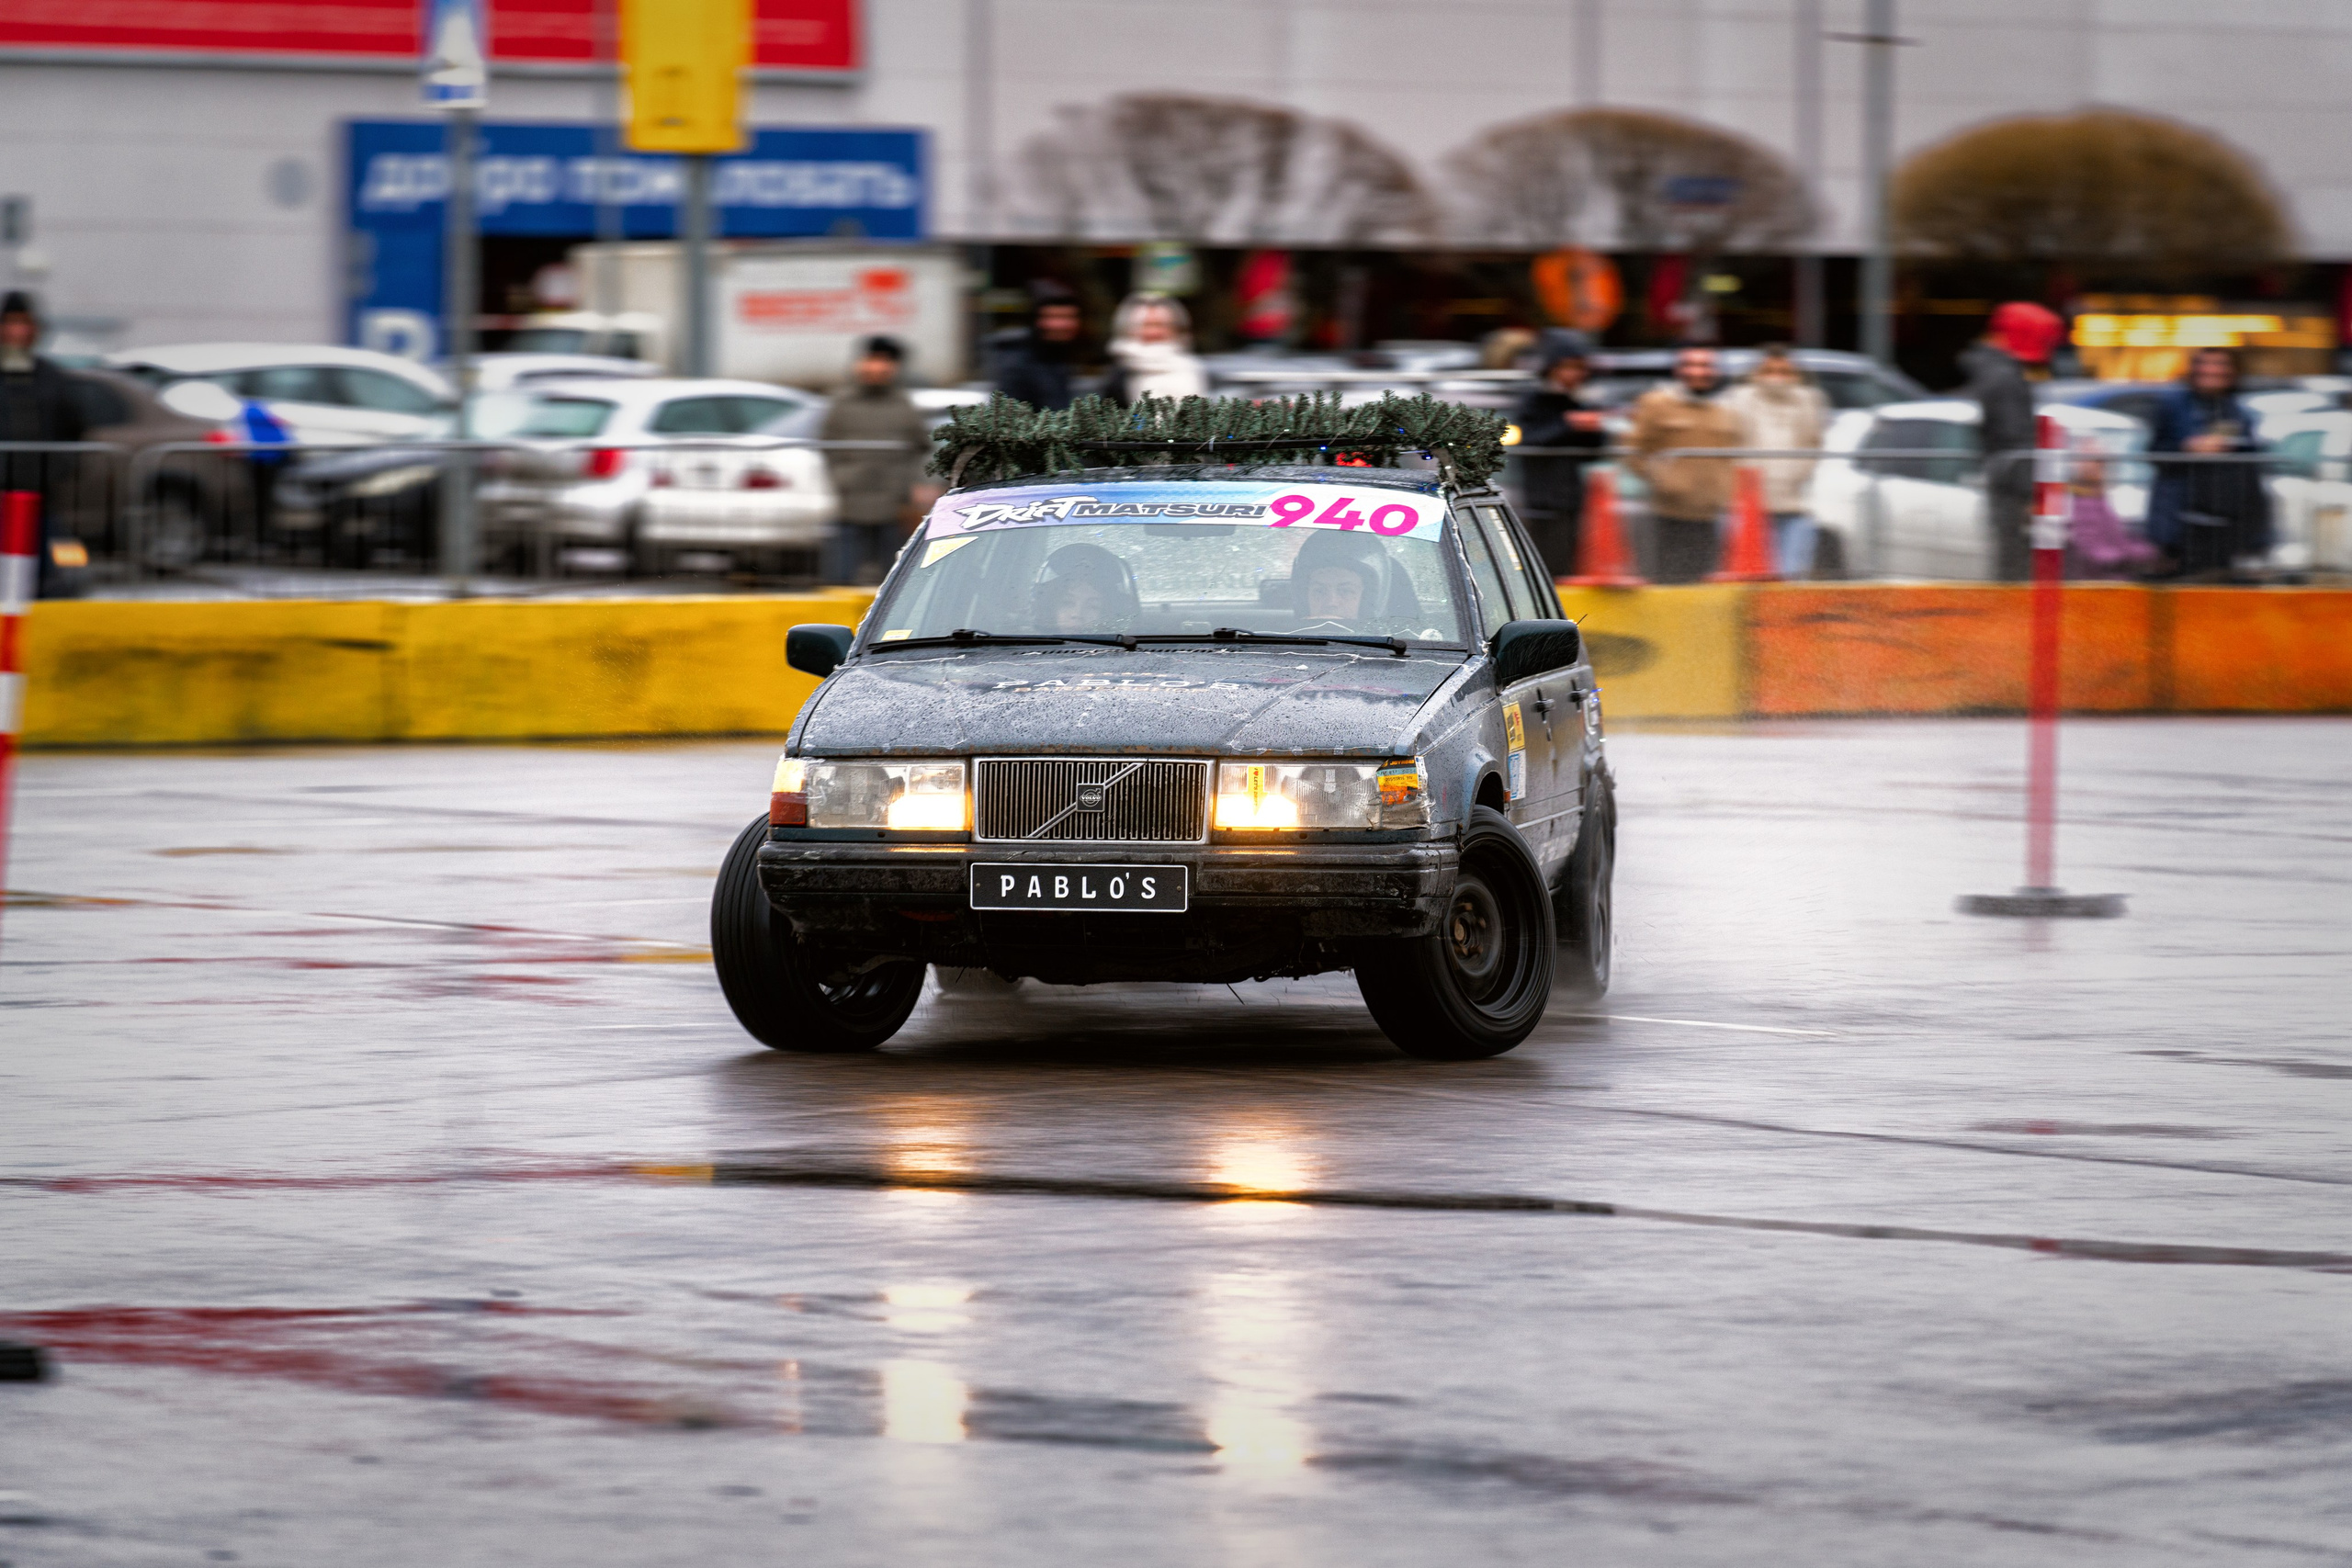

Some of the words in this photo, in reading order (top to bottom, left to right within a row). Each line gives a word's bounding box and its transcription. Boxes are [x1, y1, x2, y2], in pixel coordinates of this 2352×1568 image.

[1072, 502, 1272, 518] MATSURI
[1269, 494, 1419, 536] 940
[992, 679, 1240, 690] PABLO'S
[1001, 873, 1157, 899] PABLO'S
